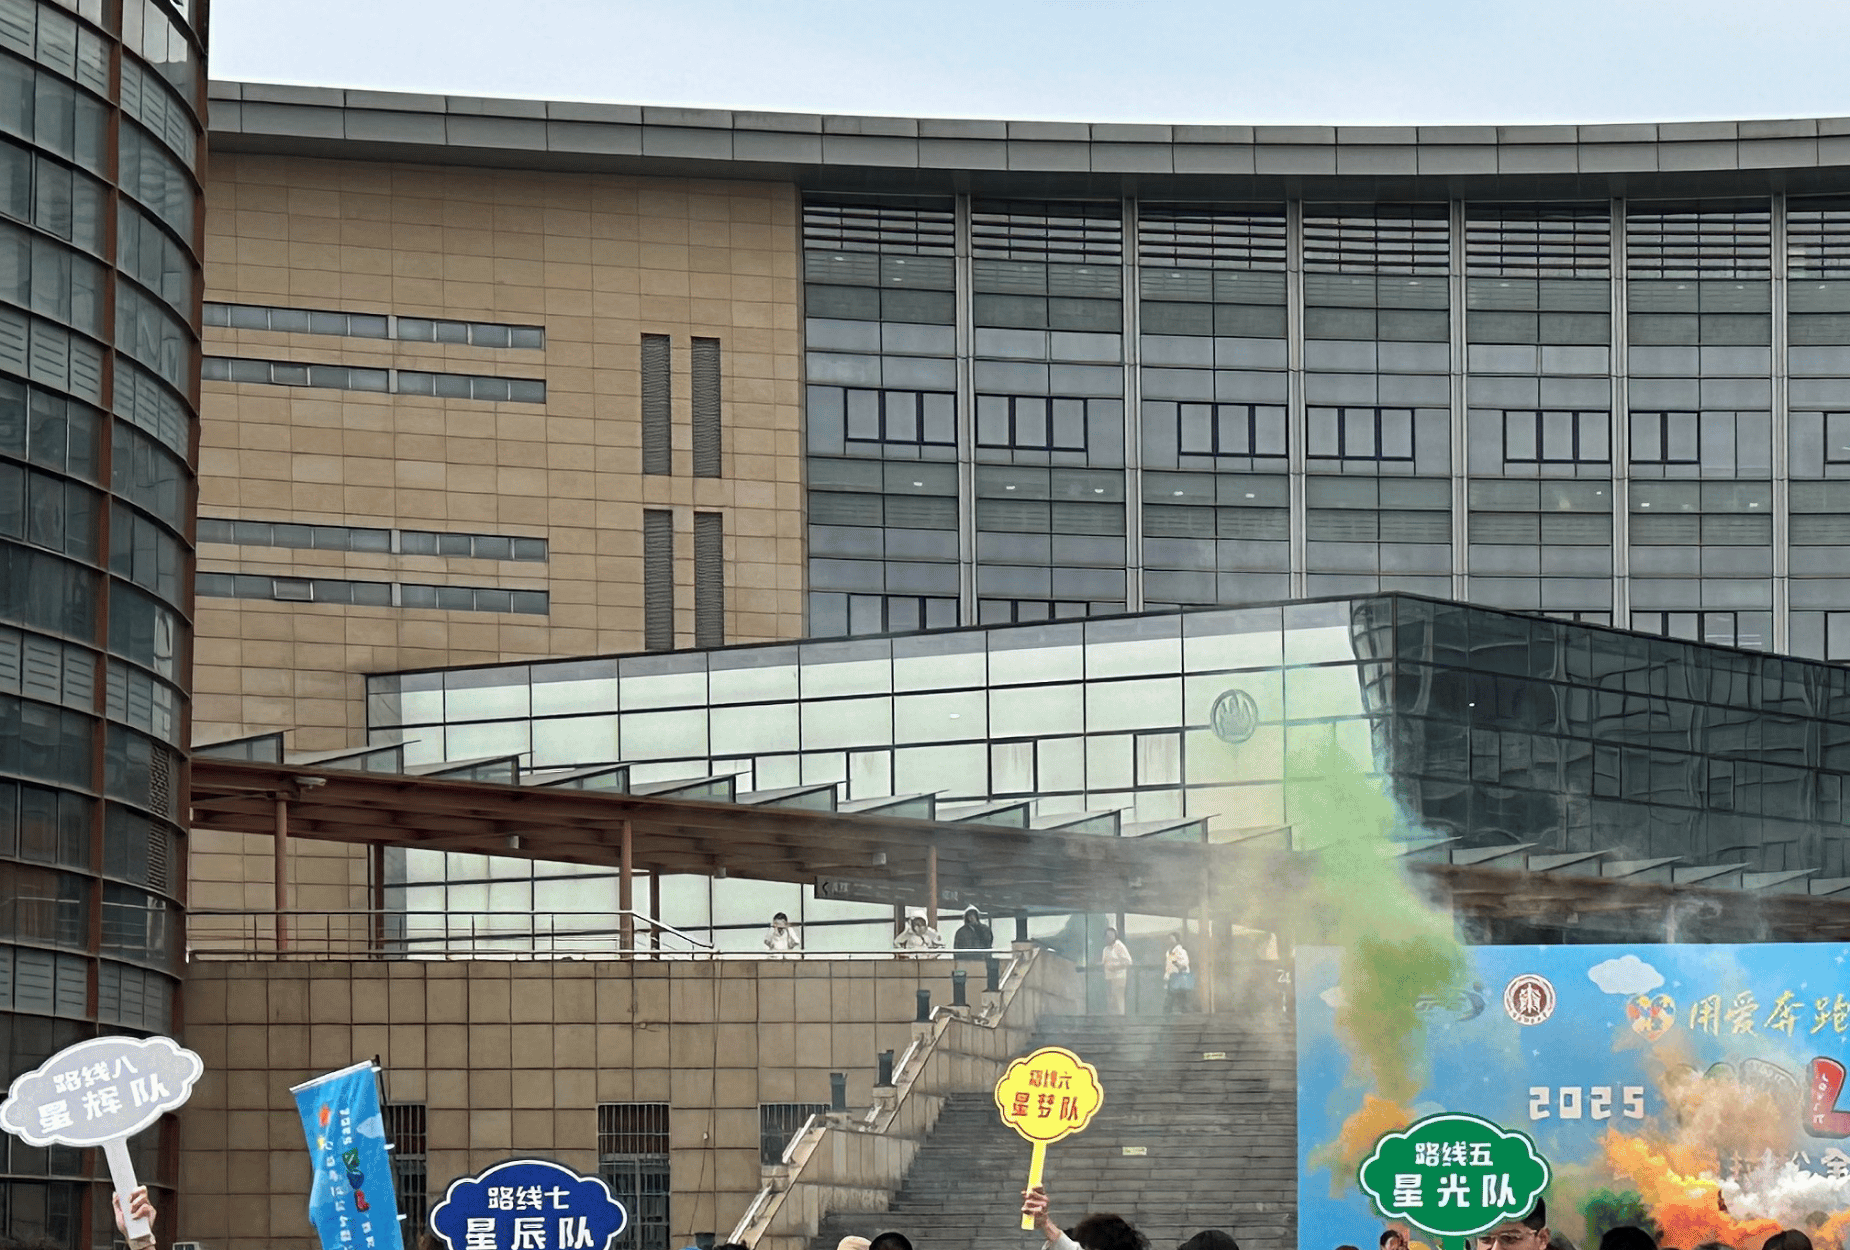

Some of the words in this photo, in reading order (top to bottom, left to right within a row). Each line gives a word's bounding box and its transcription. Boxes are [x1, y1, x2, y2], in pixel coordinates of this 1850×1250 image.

[53, 1056, 138, 1093] 路线八
[37, 1073, 170, 1134] 星辉队
[1011, 1092, 1078, 1120] 星梦队
[1529, 1086, 1645, 1120] 2025
[1415, 1141, 1493, 1166] 路线五
[487, 1185, 570, 1210] 路线七
[1393, 1173, 1516, 1207] 星光队
[465, 1216, 594, 1250] 星辰队
